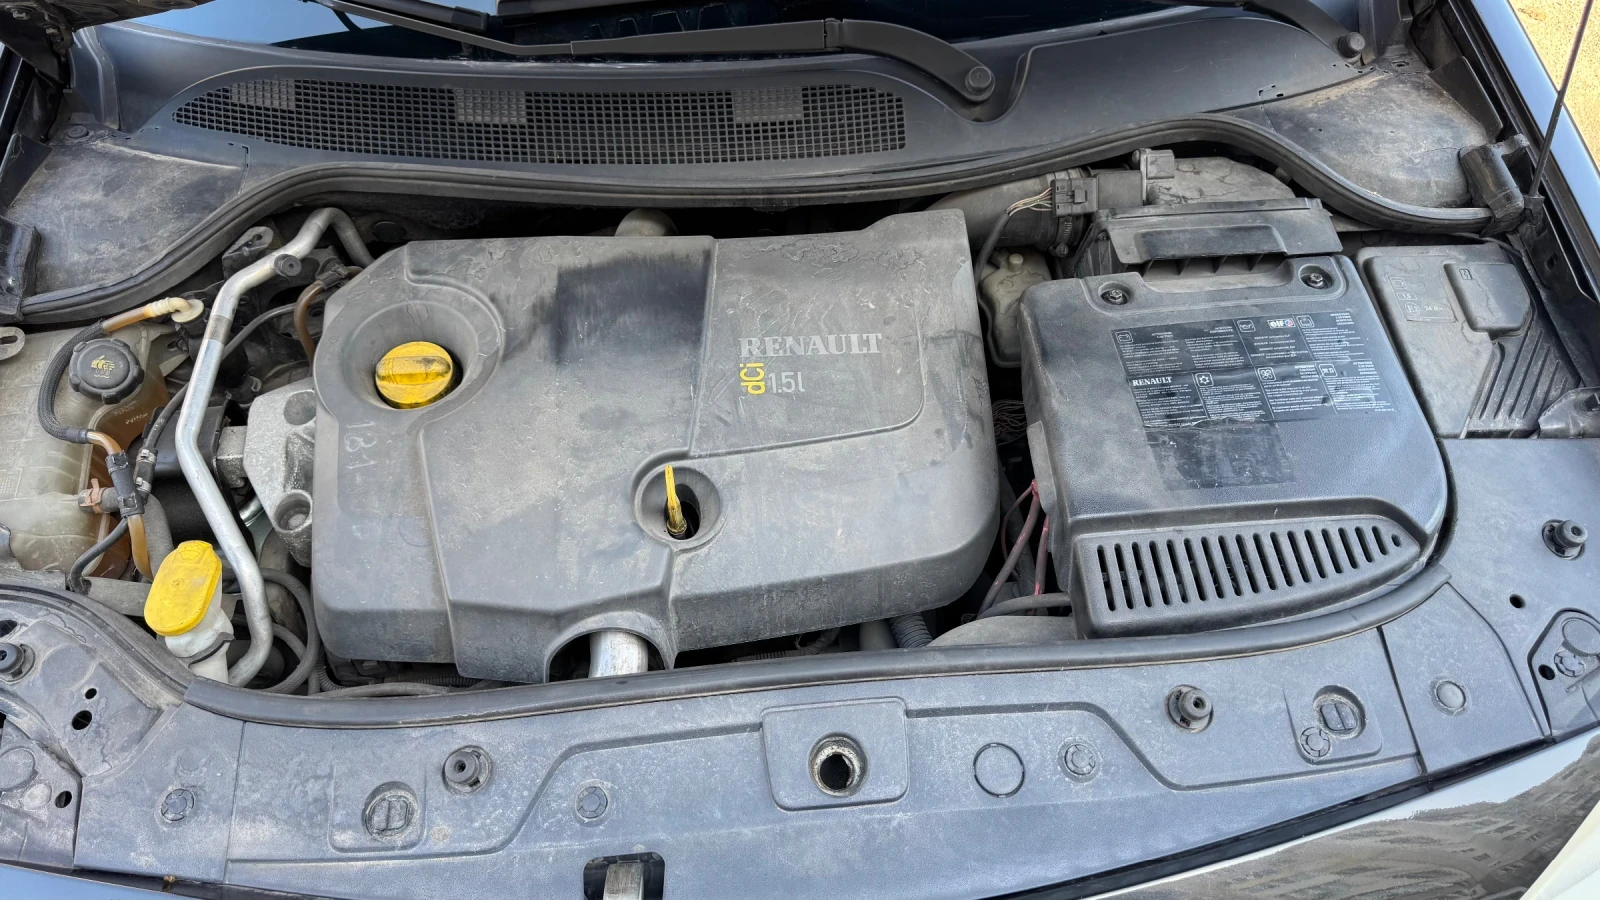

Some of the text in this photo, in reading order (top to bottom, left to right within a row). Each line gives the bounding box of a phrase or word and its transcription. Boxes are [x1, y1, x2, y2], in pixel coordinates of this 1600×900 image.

[1270, 320, 1285, 328] elf
[738, 333, 882, 358] RENAULT
[739, 362, 765, 395] dCi
[1132, 376, 1172, 387] RENAULT
